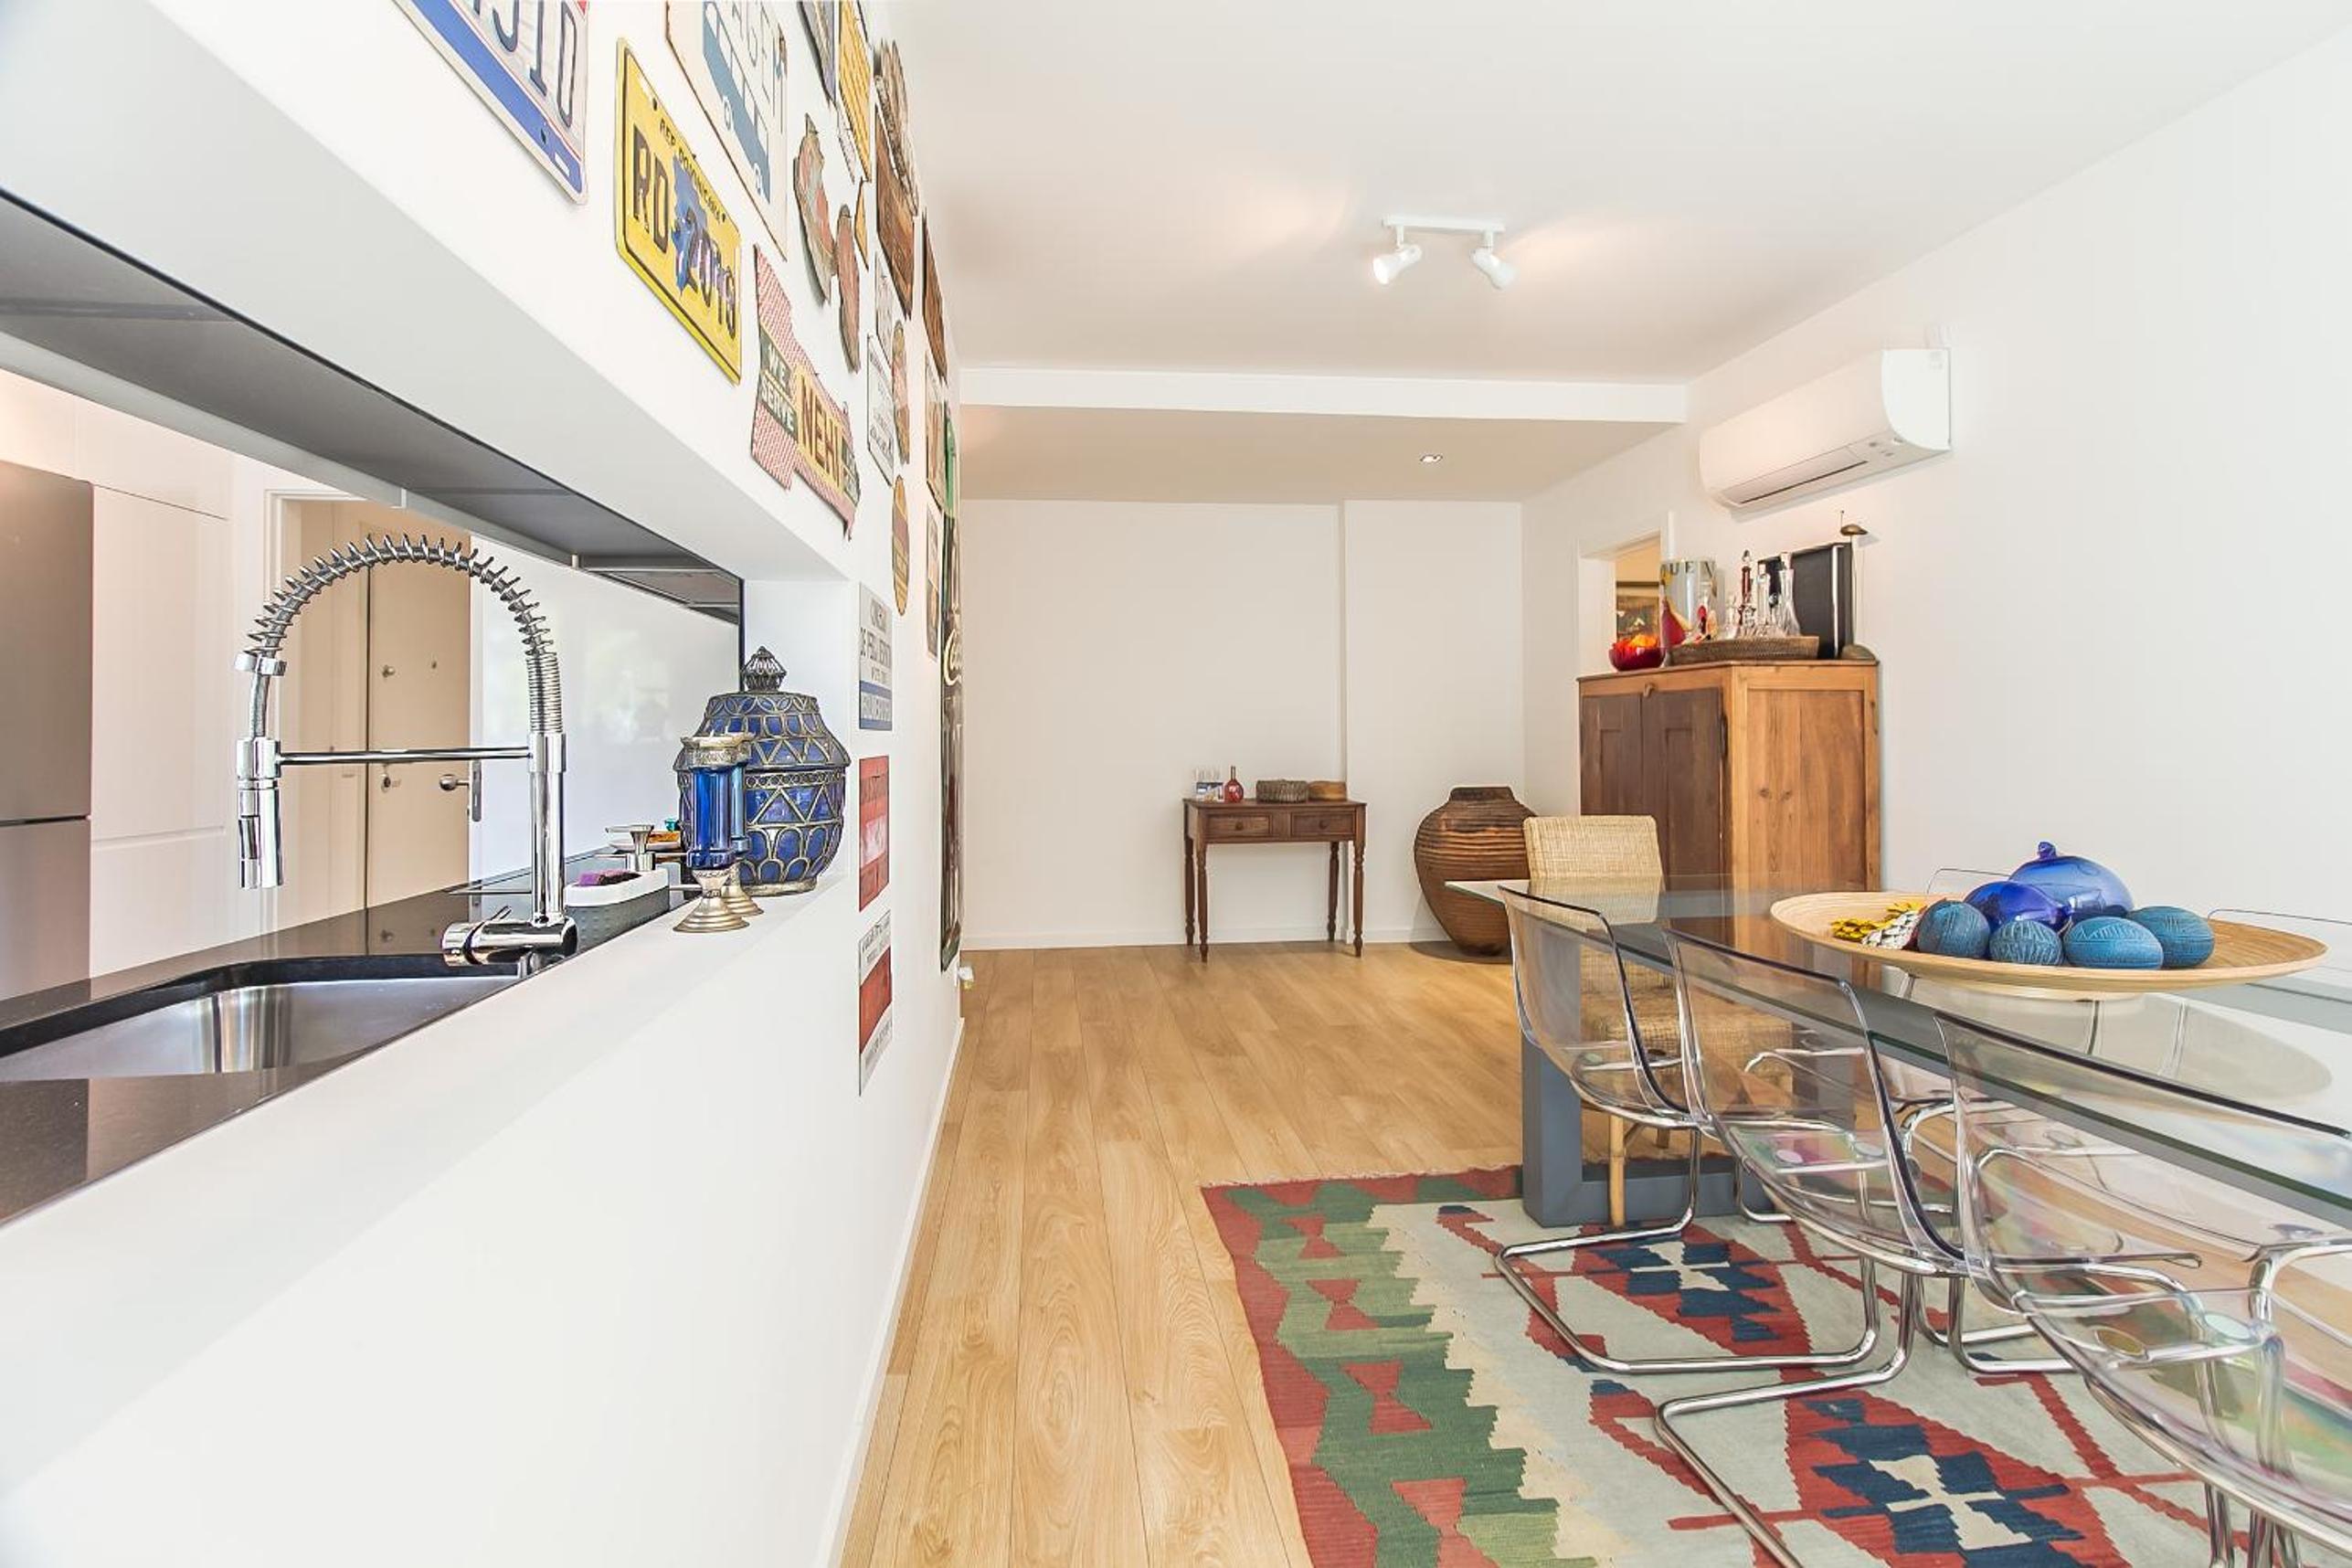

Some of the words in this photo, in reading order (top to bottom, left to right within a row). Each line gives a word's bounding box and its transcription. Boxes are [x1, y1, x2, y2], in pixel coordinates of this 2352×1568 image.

[768, 342, 788, 388] WE
[760, 374, 795, 433] SERVE
[800, 374, 841, 489] NEHI
